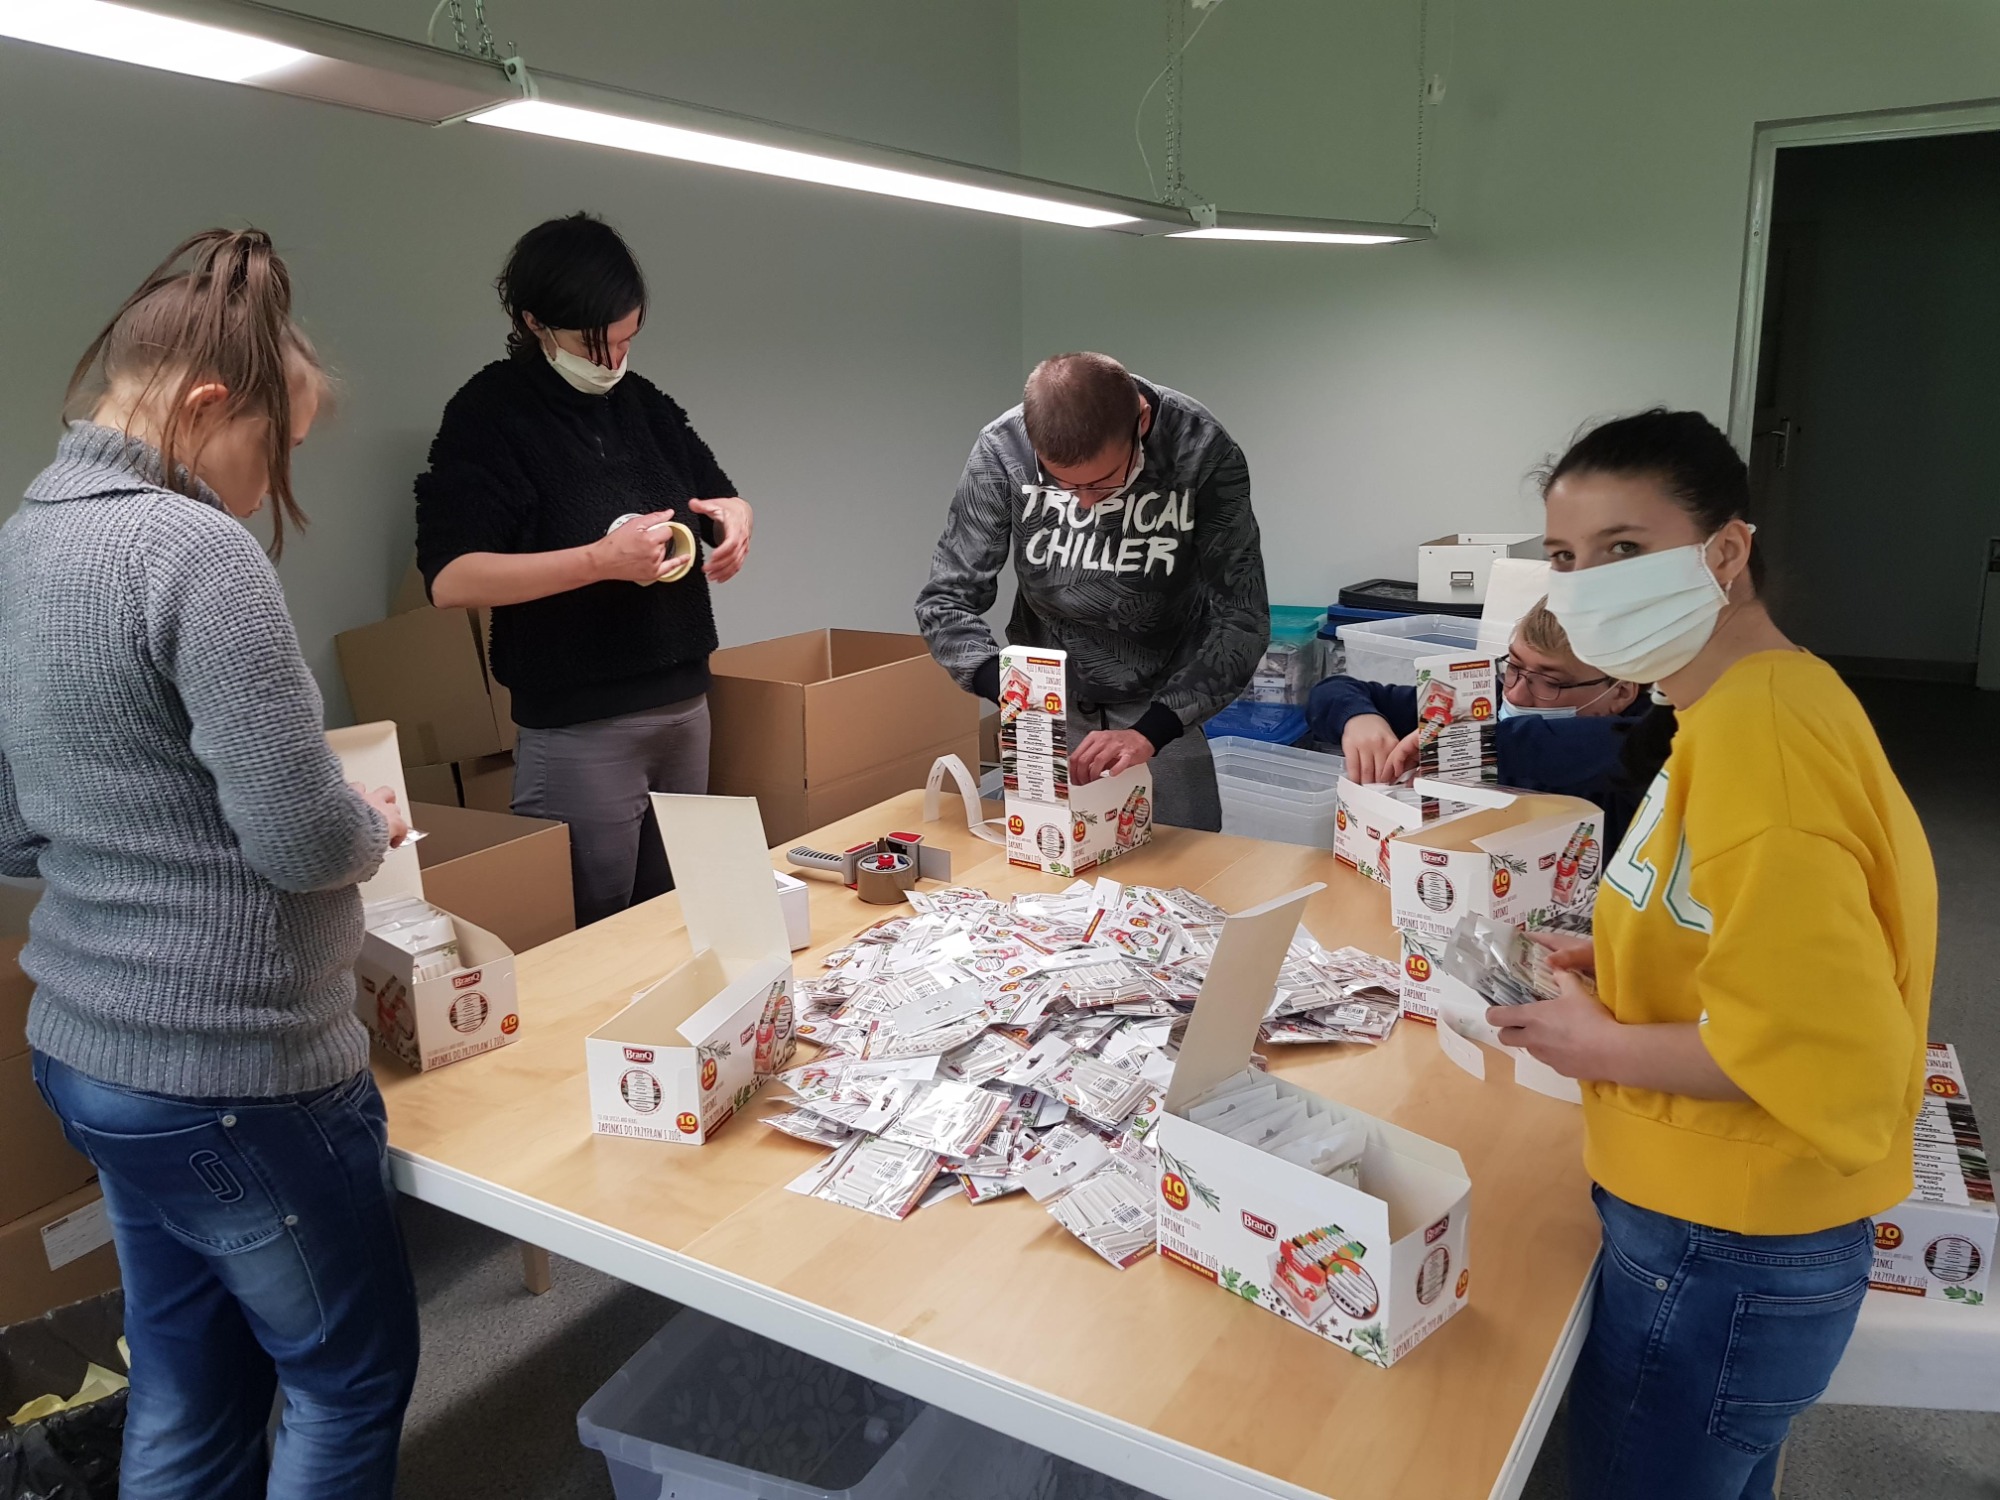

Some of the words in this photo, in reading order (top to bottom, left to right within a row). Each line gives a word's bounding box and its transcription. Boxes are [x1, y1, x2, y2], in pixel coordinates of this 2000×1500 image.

[1022, 485, 1195, 533] TROPICAL
[1026, 527, 1179, 577] CHILLER
[1046, 701, 1059, 710] 10
[1473, 706, 1488, 717] 10
[1010, 818, 1022, 827] 10
[1338, 812, 1344, 822] 10
[1075, 824, 1084, 834] 10
[1422, 852, 1446, 864] BranQ
[1495, 873, 1508, 886] 10
[1397, 916, 1418, 929] ZAPINKI
[1420, 921, 1427, 931] DO
[1409, 957, 1428, 971] 10
[454, 972, 480, 988] BranQ
[1403, 988, 1426, 1001] ZAPINKI
[1404, 1000, 1410, 1010] DO
[503, 1016, 516, 1026] 10
[625, 1049, 653, 1061] BranQ
[703, 1061, 715, 1079] 10
[1932, 1084, 1955, 1094] 10
[678, 1115, 696, 1124] 10
[598, 1122, 622, 1135] ZAPINKI
[624, 1125, 632, 1135] DO
[634, 1127, 663, 1139] PRZYPRAW
[1165, 1176, 1185, 1197] 10
[1165, 1193, 1184, 1206] sztuk
[1161, 1214, 1185, 1237] ZAPINKI
[1243, 1213, 1274, 1237] BranQ
[1875, 1226, 1899, 1239] 10
[1161, 1231, 1169, 1245] DO
[1170, 1236, 1199, 1260] PRZYPRAW
[1205, 1253, 1218, 1271] ZIÓŁ
[1873, 1258, 1893, 1269] PINKI
[1874, 1271, 1907, 1284] PRZYPRAW
